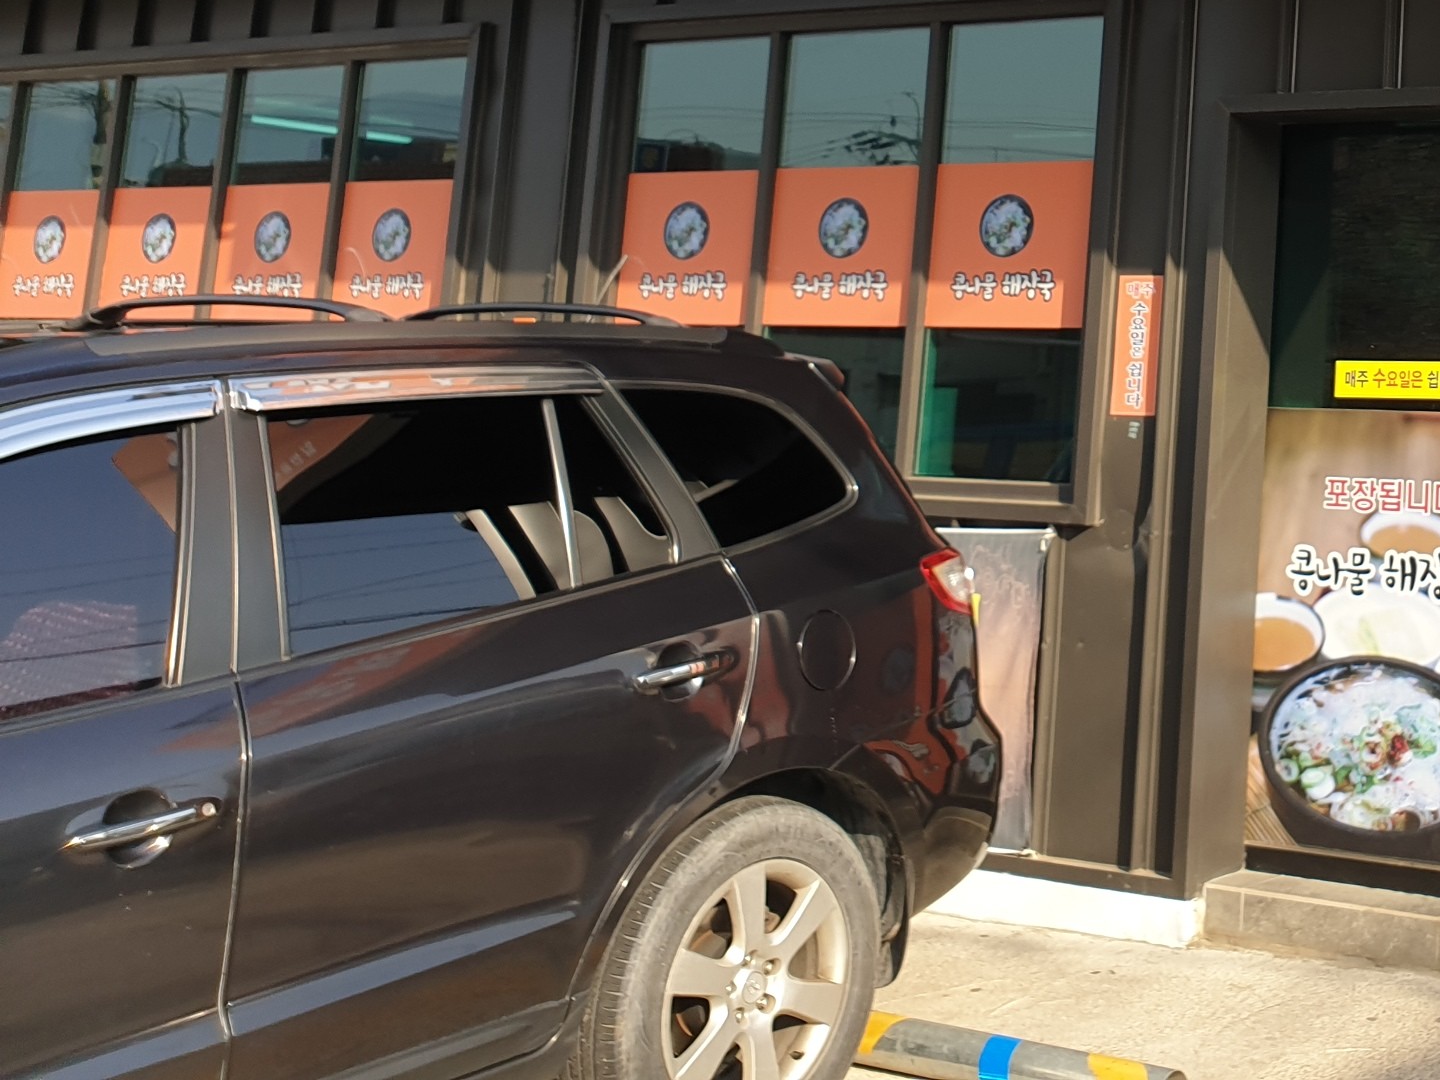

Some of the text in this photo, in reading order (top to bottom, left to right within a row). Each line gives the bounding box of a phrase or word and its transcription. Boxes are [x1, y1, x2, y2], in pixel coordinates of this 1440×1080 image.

[639, 271, 727, 301] 콩나물 해장국
[792, 270, 888, 301] 콩나물 해장국
[951, 269, 1056, 302] 콩나물 해장국
[1126, 302, 1148, 407] 수요일은 쉽니다
[1345, 370, 1370, 389] 매주
[1372, 370, 1424, 390] 수요일은
[1287, 546, 1374, 596] 콩나물
